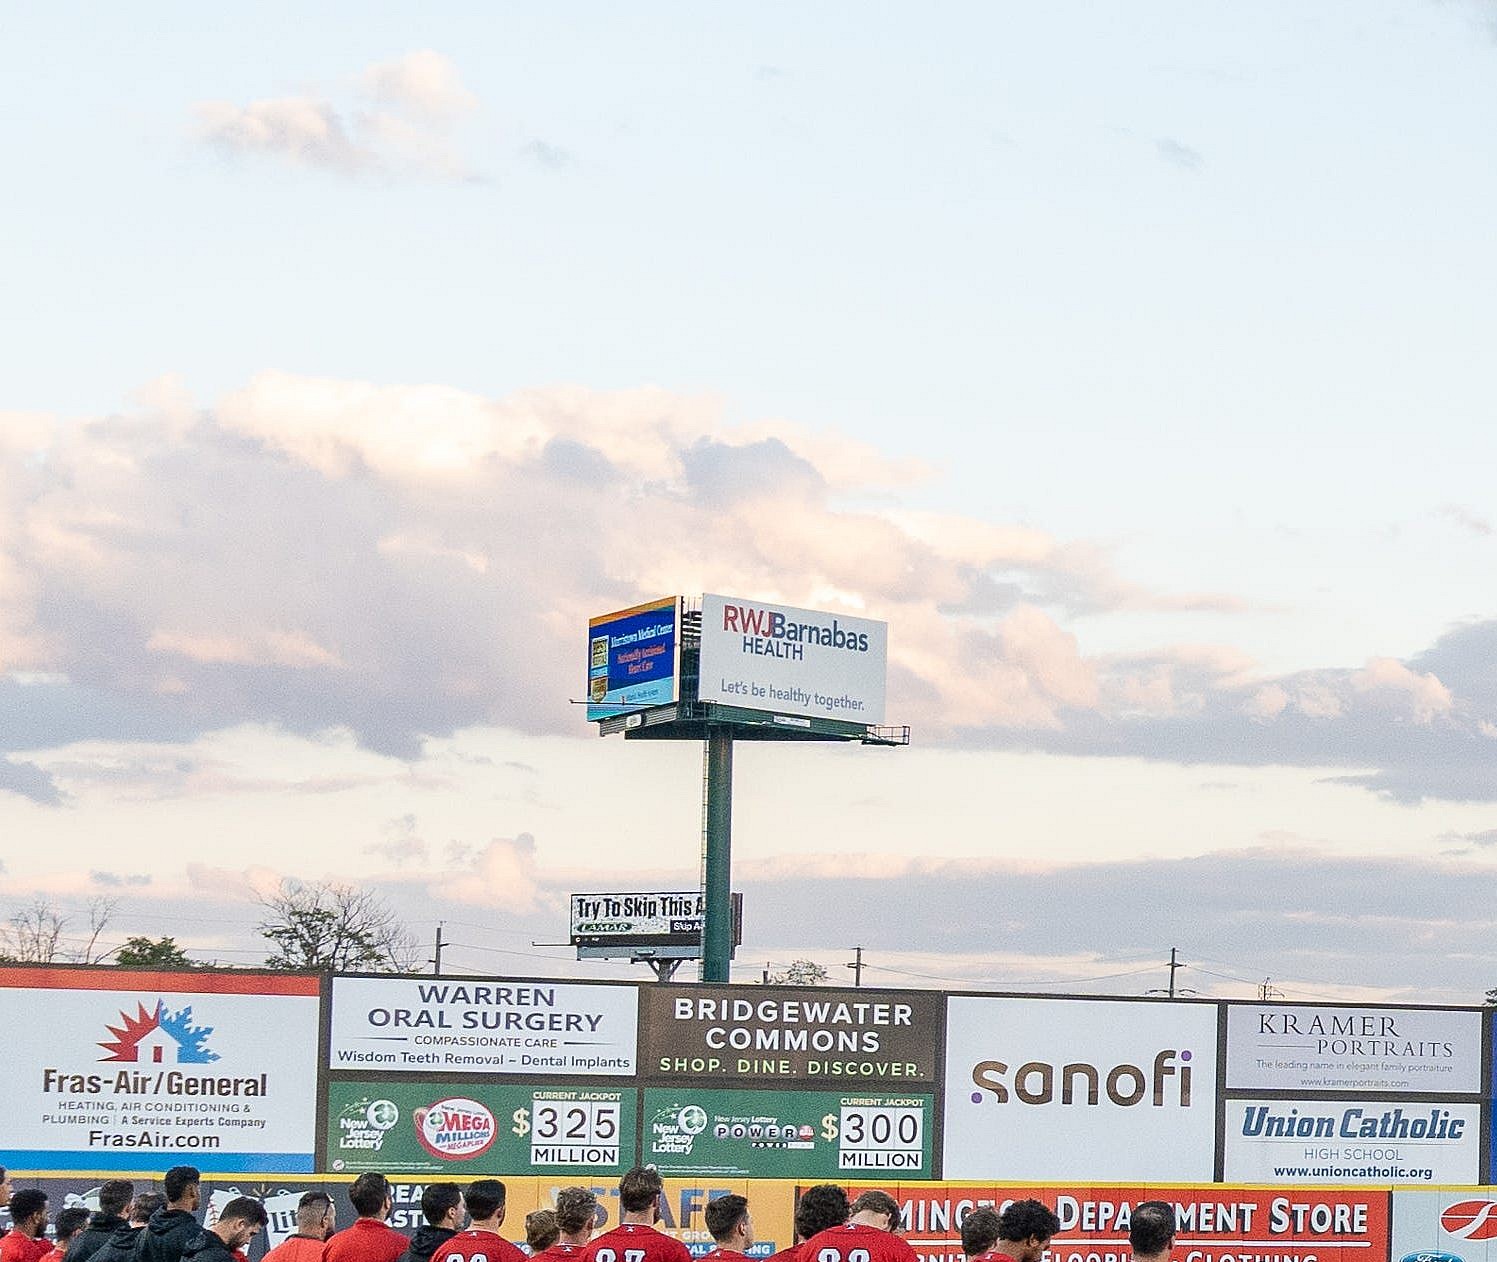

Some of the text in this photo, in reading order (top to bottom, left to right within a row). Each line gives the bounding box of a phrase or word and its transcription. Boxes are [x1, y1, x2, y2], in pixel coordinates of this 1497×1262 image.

[723, 604, 868, 653] RWJBarnabas
[742, 637, 804, 661] HEALTH
[721, 678, 864, 712] Let's be healthy together.
[577, 898, 600, 920] Try
[603, 897, 620, 917] To
[624, 897, 656, 918] Skip
[660, 896, 692, 916] This
[418, 985, 554, 1006] WARREN
[368, 1008, 604, 1032] ORAL SURGERY
[674, 998, 913, 1026] BRIDGEWATER
[1260, 1014, 1400, 1038] KRAMER
[414, 1035, 558, 1048] COMPASSIONATE CARE
[706, 1027, 880, 1053] COMMONS
[1318, 1040, 1454, 1058] PORTRAITS
[338, 1050, 630, 1068] Wisdom Teeth Removal Dental Implants
[660, 1058, 924, 1077] SHOP. DINE. DISCOVER.
[42, 1068, 268, 1097] Fras-Air/General
[971, 1049, 1192, 1108] sanofi
[533, 1092, 622, 1101] CURRENT JACKPOT
[840, 1098, 924, 1107] CURRENT JACKPOT
[58, 1102, 251, 1113] HEATING, AIR CONDITIONING &
[42, 1114, 266, 1129] PLUMBING A Service Experts Company
[340, 1118, 368, 1130] New
[438, 1112, 490, 1132] MEGA
[652, 1123, 680, 1134] New
[1242, 1106, 1466, 1140] Union Catholic
[89, 1131, 220, 1148] FrasAir.com
[340, 1138, 384, 1150] Lottery
[652, 1142, 692, 1155] Lottery
[659, 1133, 694, 1146] Jersey
[534, 1149, 616, 1162] MILLION
[842, 1153, 918, 1167] MILLION
[1304, 1148, 1404, 1161] HIGH SCHOOL
[1274, 1164, 1433, 1180] www.unioncatholic.org
